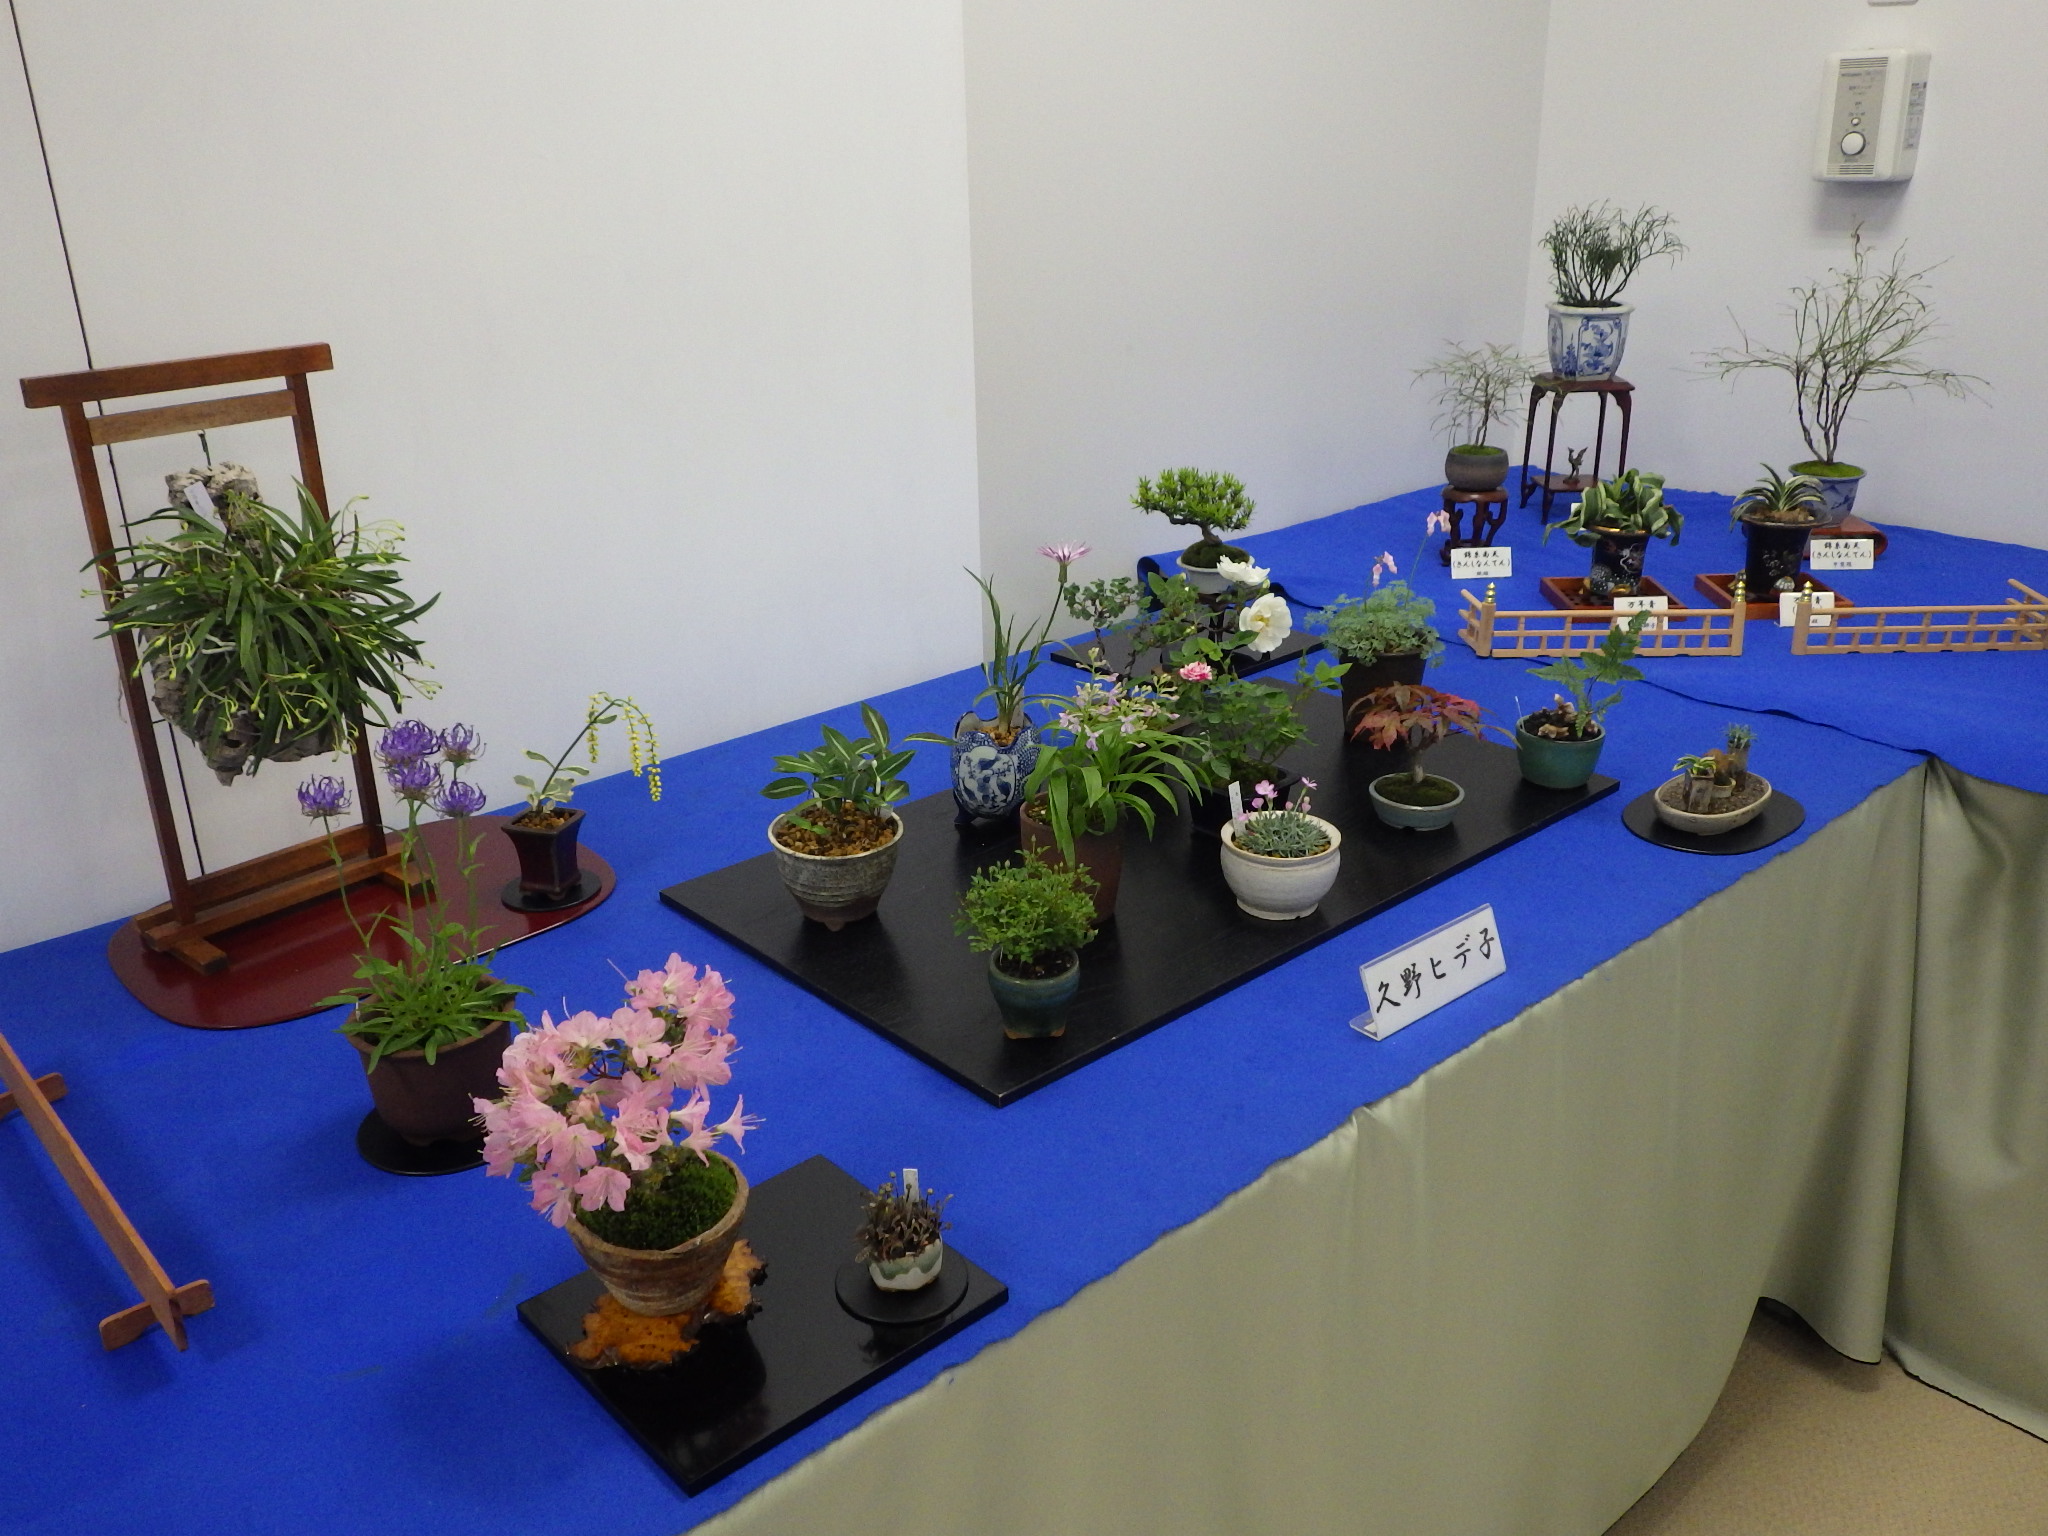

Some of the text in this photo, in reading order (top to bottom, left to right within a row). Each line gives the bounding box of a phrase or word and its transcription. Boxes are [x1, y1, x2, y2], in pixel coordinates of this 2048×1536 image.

[1376, 927, 1495, 1014] 久野ヒデ子
